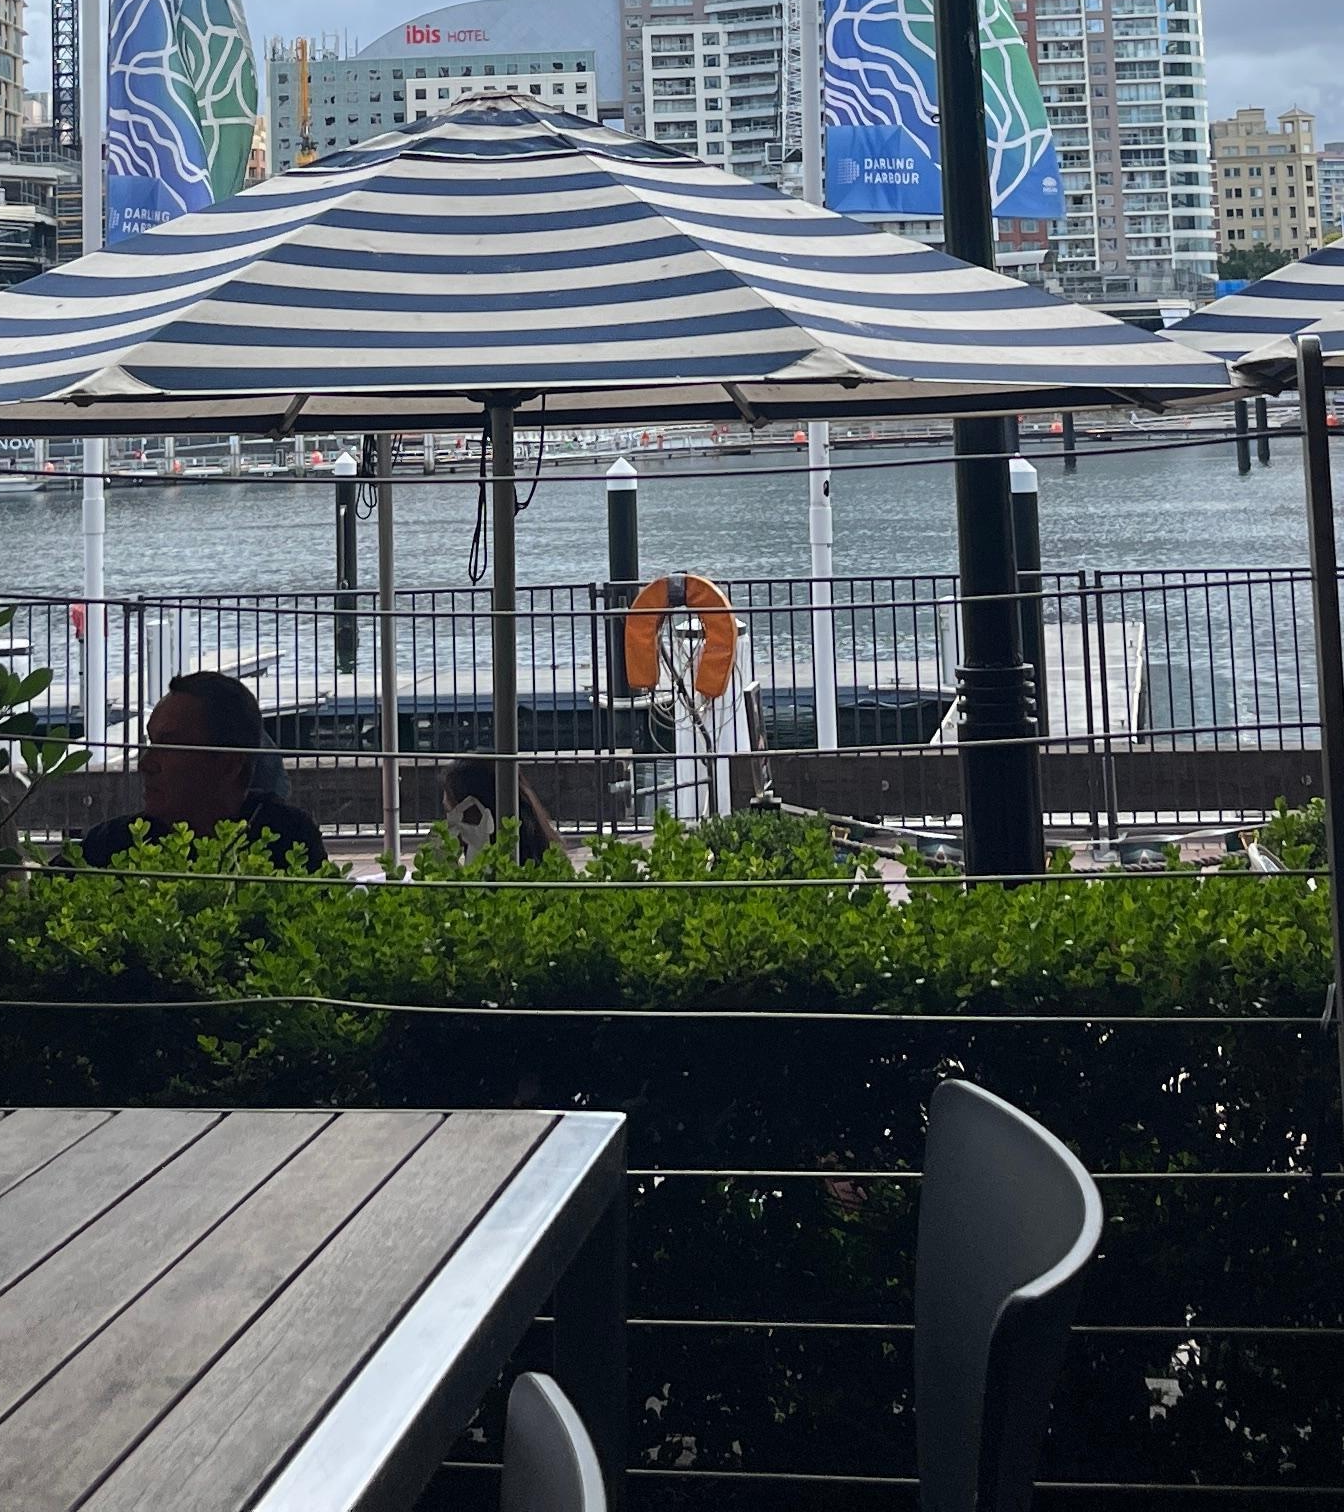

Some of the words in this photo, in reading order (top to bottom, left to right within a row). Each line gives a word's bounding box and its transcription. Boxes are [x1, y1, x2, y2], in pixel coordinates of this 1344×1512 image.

[406, 23, 441, 44] ibis
[447, 29, 490, 43] HOTEL
[864, 157, 914, 170] DARLING
[864, 172, 919, 184] HARBOUR
[124, 207, 171, 222] DARLING
